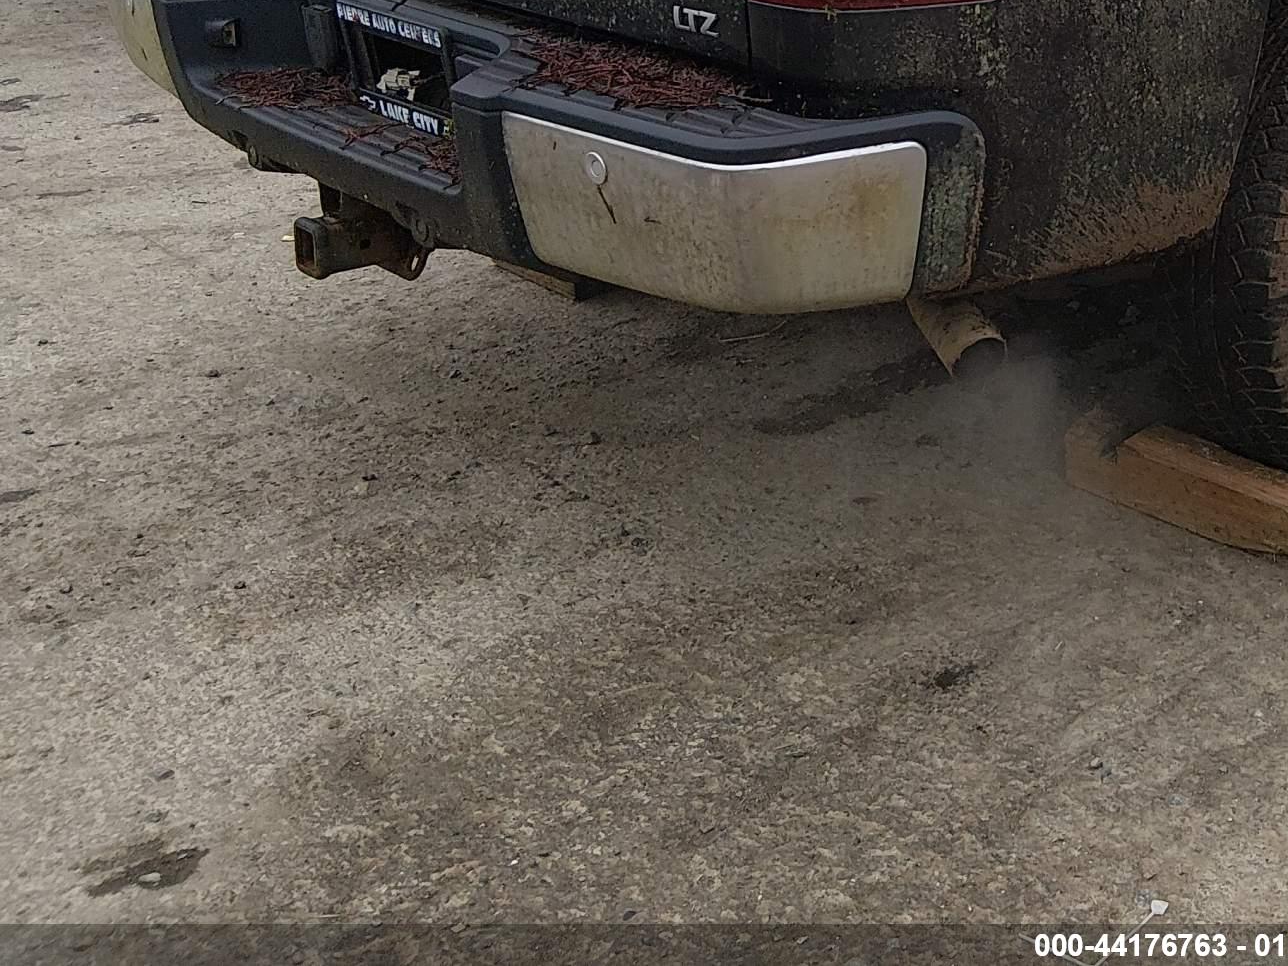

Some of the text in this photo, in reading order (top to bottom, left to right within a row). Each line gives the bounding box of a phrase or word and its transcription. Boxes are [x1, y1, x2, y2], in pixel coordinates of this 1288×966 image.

[372, 13, 397, 34] AUTO
[673, 5, 719, 37] LTZ
[379, 99, 410, 124] LAKE
[412, 111, 440, 136] CITY
